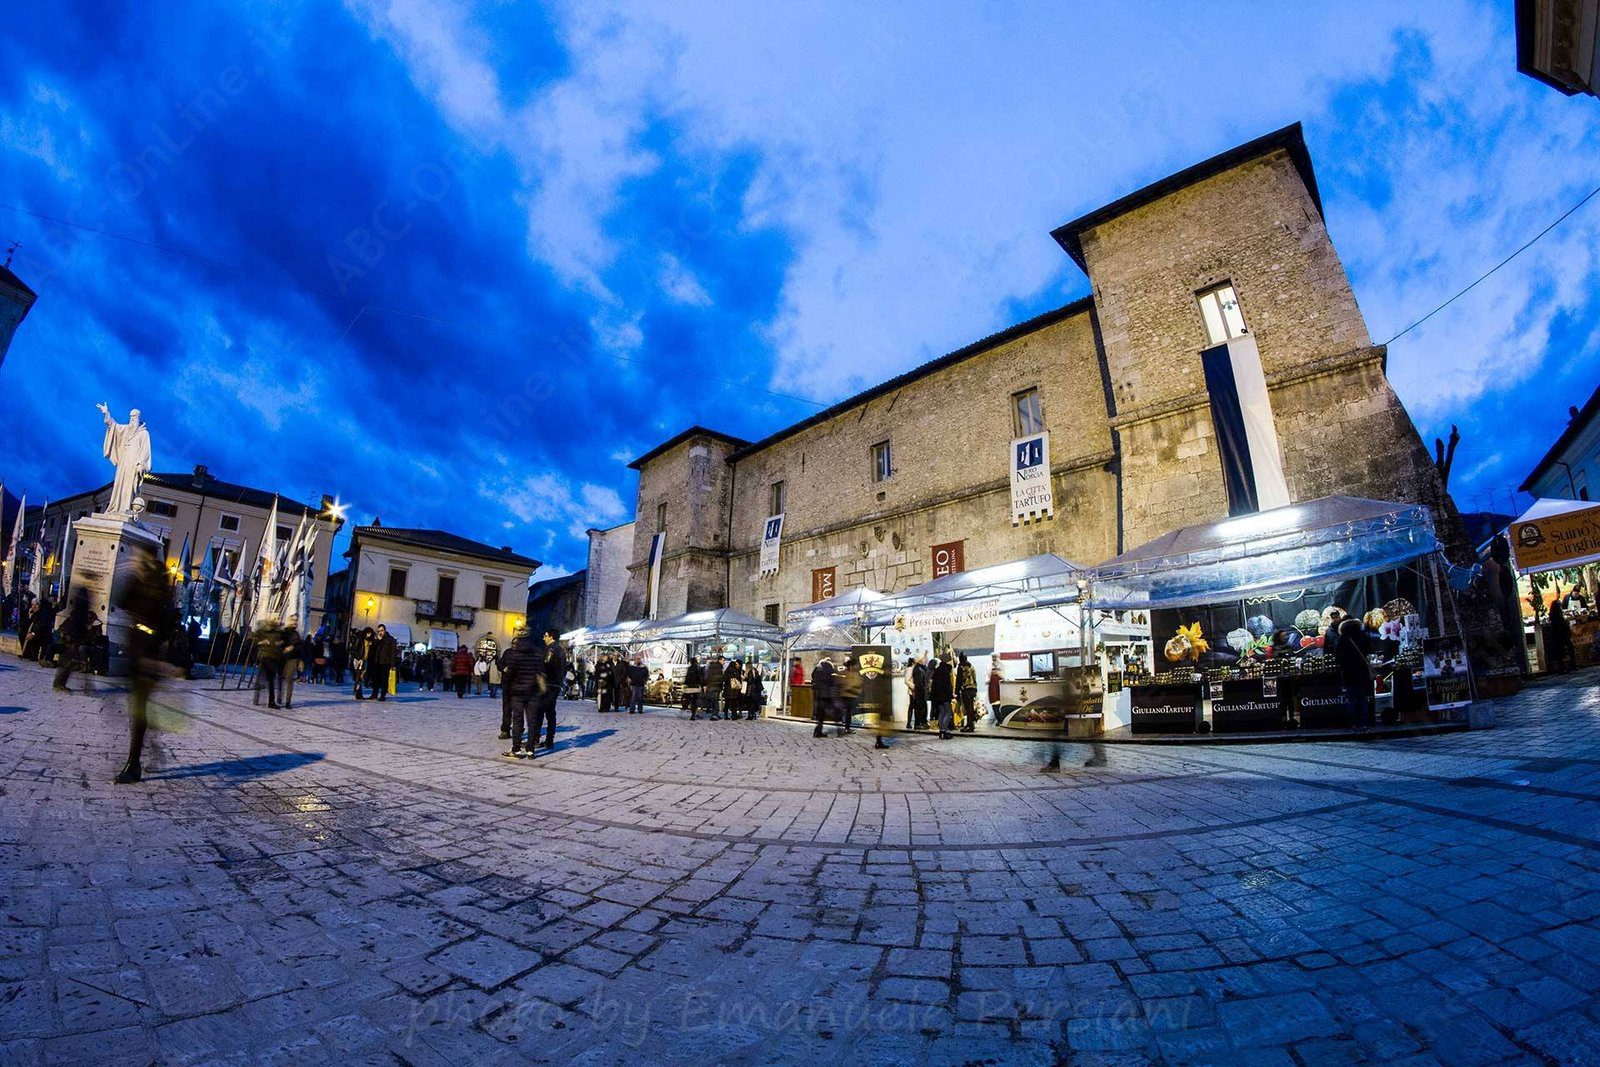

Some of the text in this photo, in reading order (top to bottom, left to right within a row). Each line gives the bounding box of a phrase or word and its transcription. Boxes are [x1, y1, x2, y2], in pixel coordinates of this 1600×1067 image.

[1014, 493, 1051, 509] TARTUFO
[1550, 526, 1591, 543] Suino
[966, 608, 998, 622] Norcia
